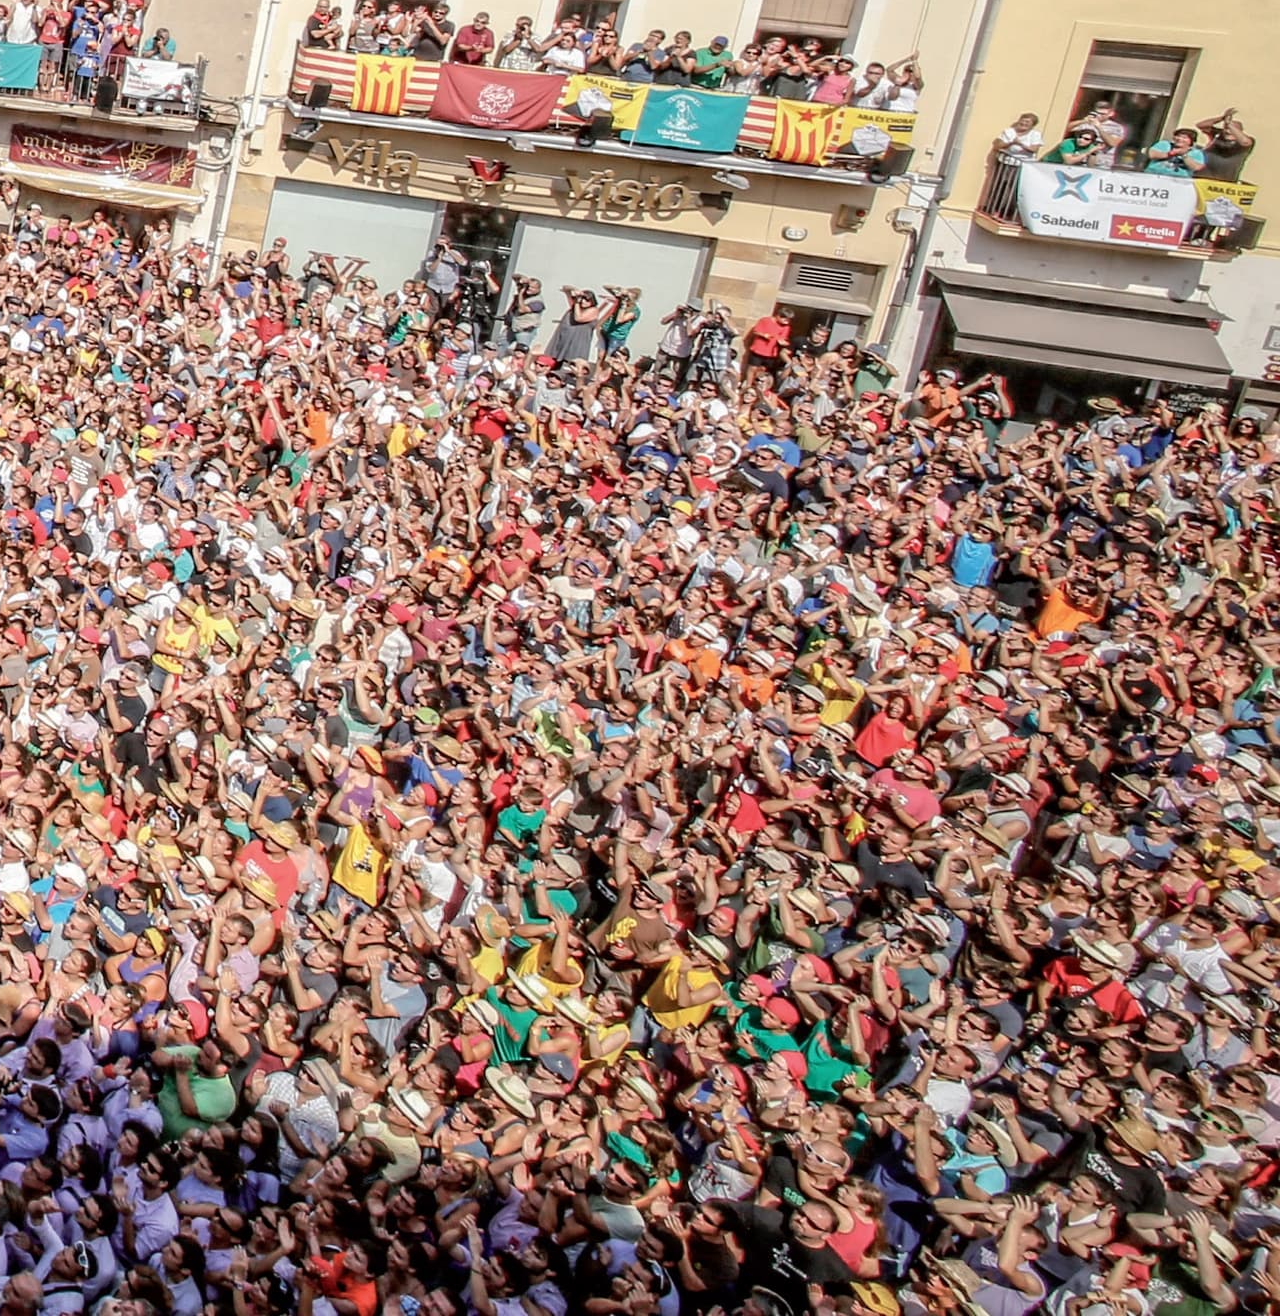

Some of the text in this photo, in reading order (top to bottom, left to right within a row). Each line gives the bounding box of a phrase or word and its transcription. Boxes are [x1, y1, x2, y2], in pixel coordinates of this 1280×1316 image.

[21, 148, 58, 163] FORN
[327, 138, 419, 178] Vila
[1098, 178, 1170, 200] la xarxa
[1135, 224, 1176, 237] Estrella
